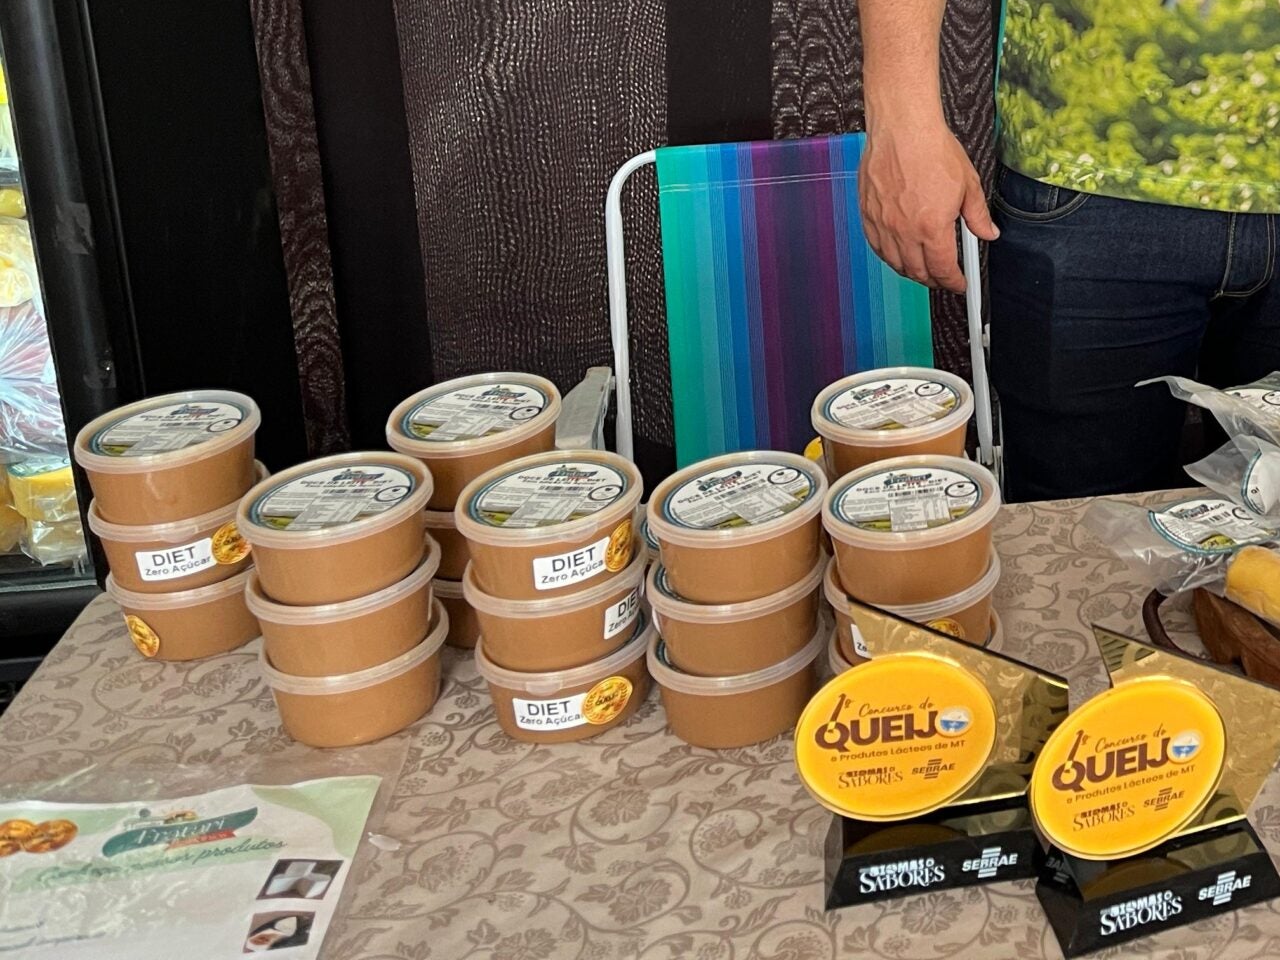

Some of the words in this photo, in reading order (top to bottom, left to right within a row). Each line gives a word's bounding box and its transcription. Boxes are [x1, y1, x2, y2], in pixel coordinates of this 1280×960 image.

[145, 568, 169, 577] Zero
[172, 556, 211, 572] Açúcar
[152, 546, 196, 567] DIET
[552, 547, 596, 573] DIET
[541, 573, 568, 584] Zero
[570, 559, 603, 577] Açúca
[617, 591, 640, 617] DIE
[527, 700, 570, 716] DIET
[859, 703, 913, 718] Concurso
[519, 715, 543, 725] Zero
[840, 749, 888, 762] Produtos
[890, 744, 932, 755] Lácteos
[934, 741, 948, 750] de
[950, 739, 966, 748] MT
[1095, 732, 1147, 753] Concurso
[838, 770, 904, 789] SABORES
[911, 761, 956, 776] SEBRAE
[1075, 784, 1122, 802] Produtos
[1123, 774, 1164, 790] Lácteos
[1166, 770, 1179, 779] de
[1180, 764, 1196, 775] MT
[1143, 789, 1185, 808] SEBRAE
[1072, 806, 1135, 832] SABORES
[192, 837, 287, 865] produtos
[961, 852, 1018, 872] SEBRAE
[859, 865, 945, 893] SABORES
[1197, 874, 1252, 901] SEBRAE
[1100, 896, 1183, 936] SABORES
